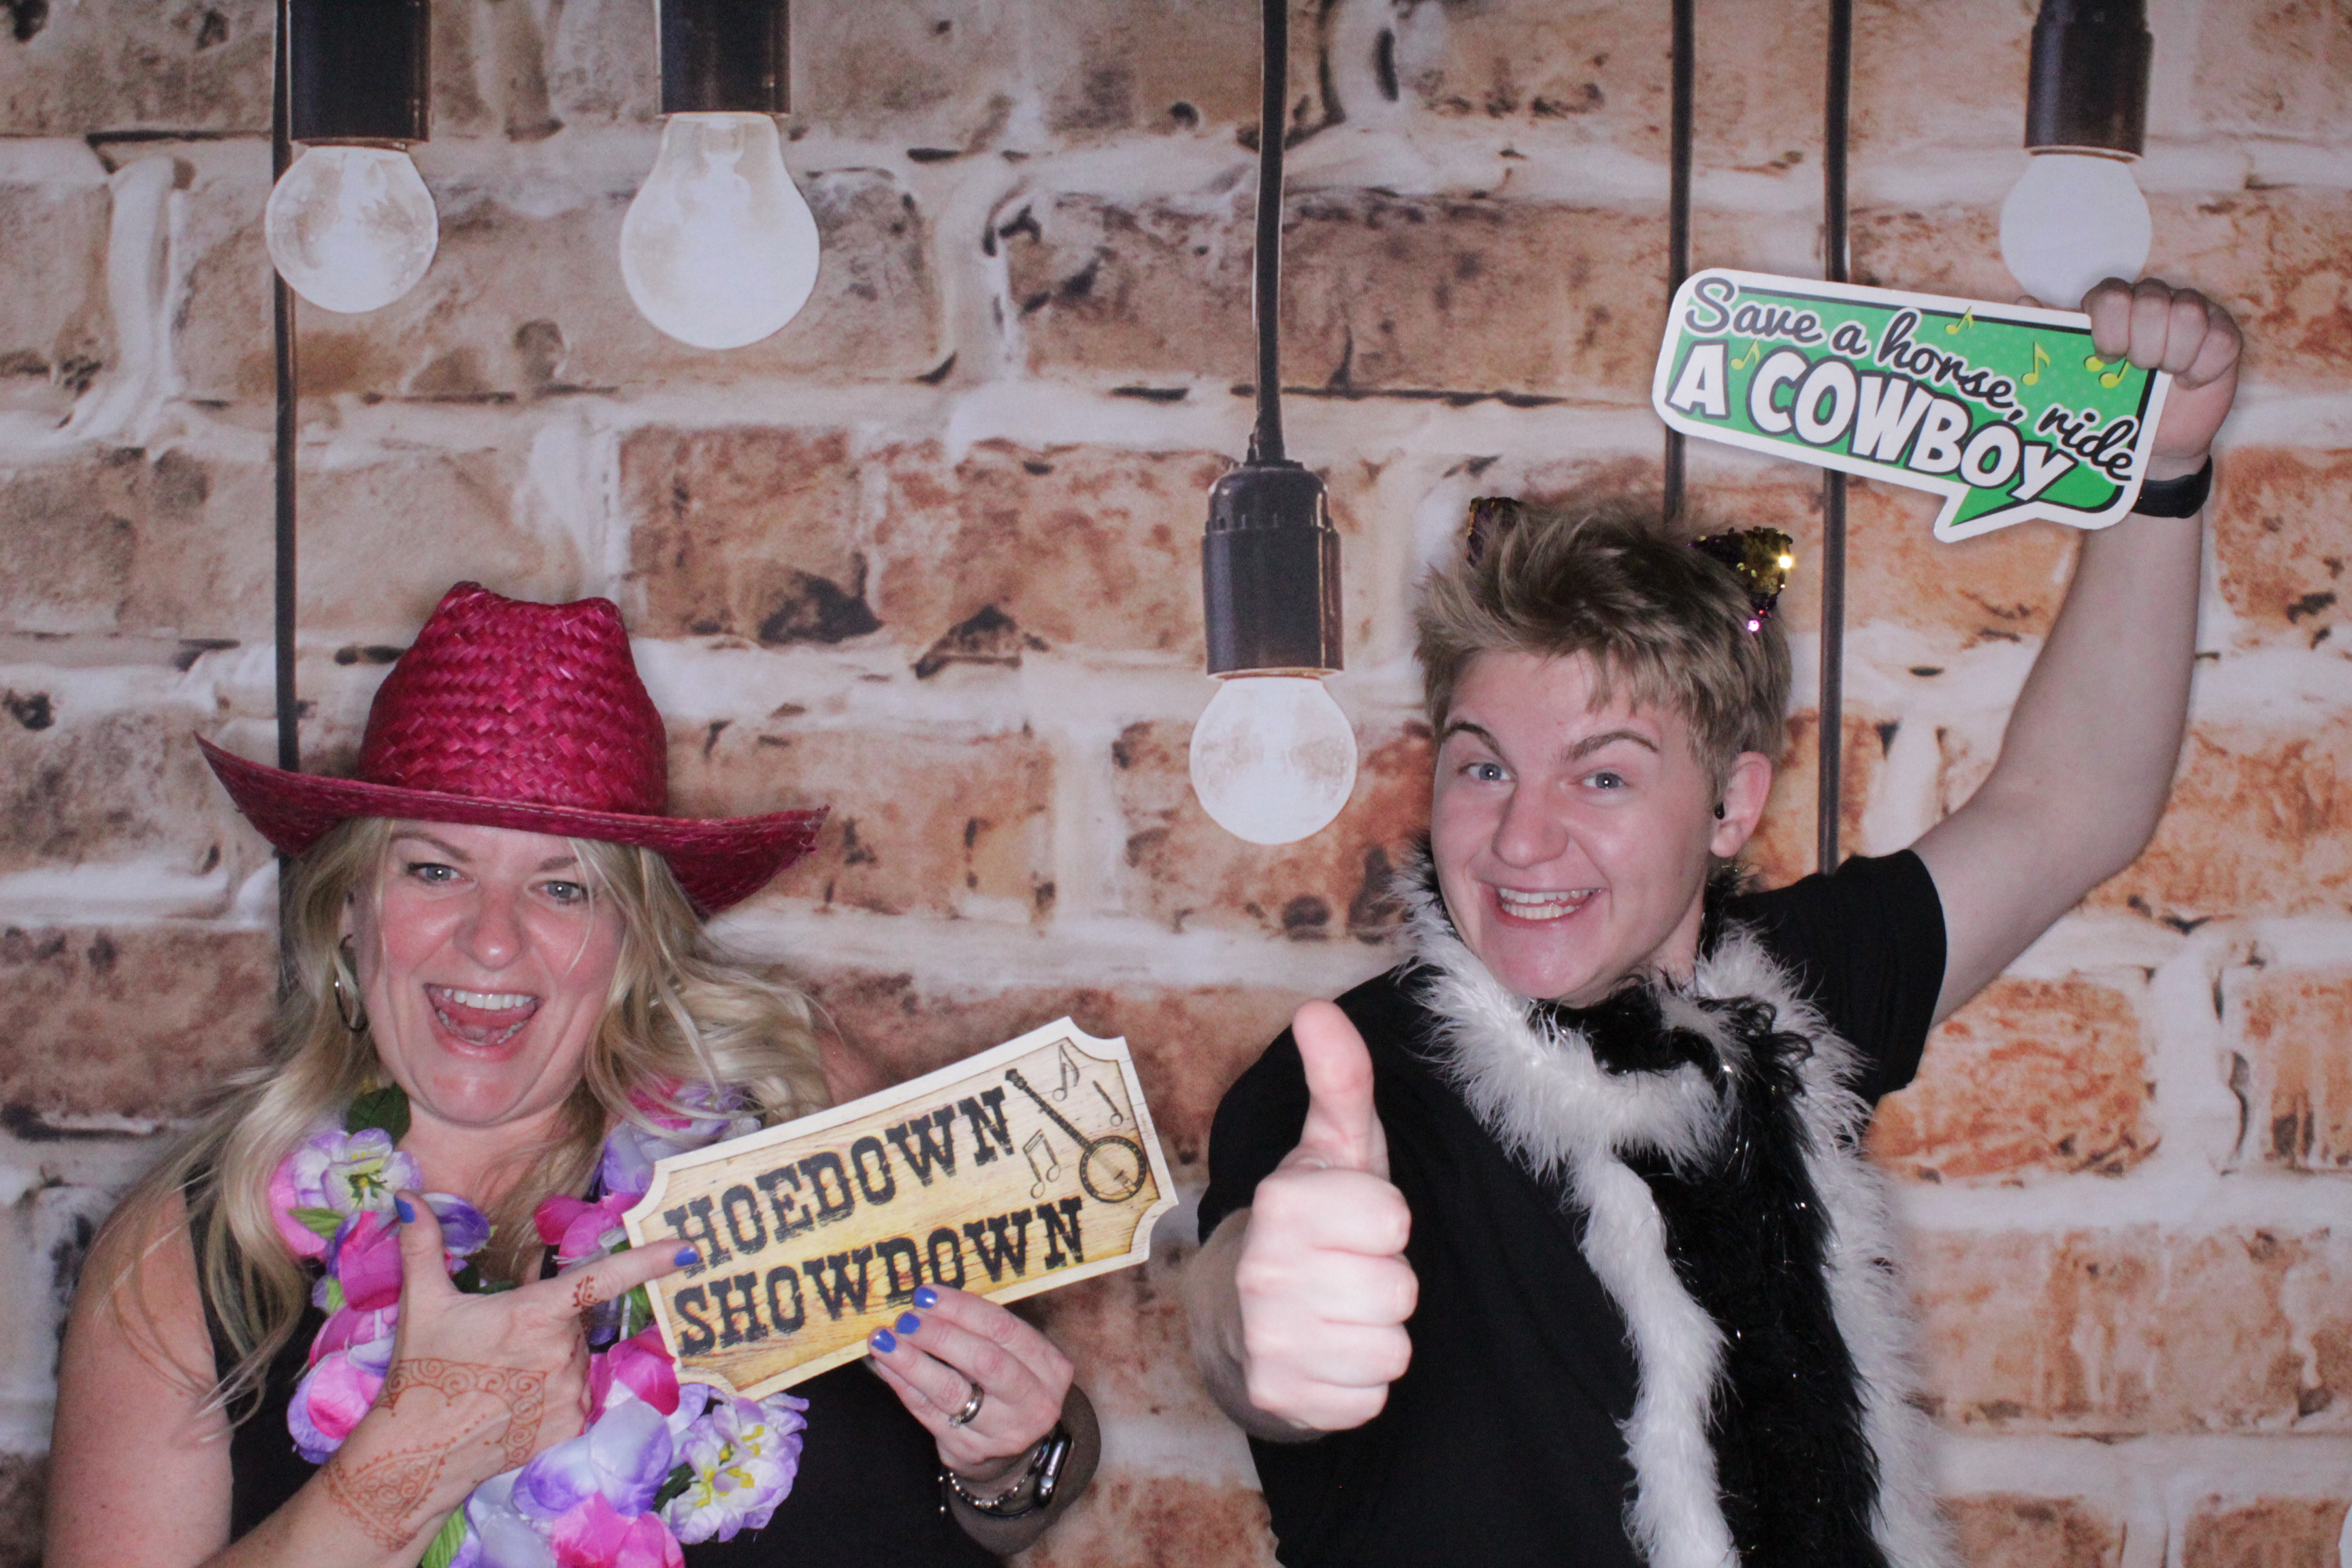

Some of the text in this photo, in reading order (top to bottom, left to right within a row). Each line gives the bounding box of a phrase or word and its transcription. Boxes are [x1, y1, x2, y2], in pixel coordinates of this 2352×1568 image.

[1667, 340, 2078, 502] A COWBOY
[1685, 278, 2132, 481] Save a horse, ride
[664, 1085, 1015, 1278] HOEDOWN
[674, 1196, 1084, 1357] SHOWDOWN
